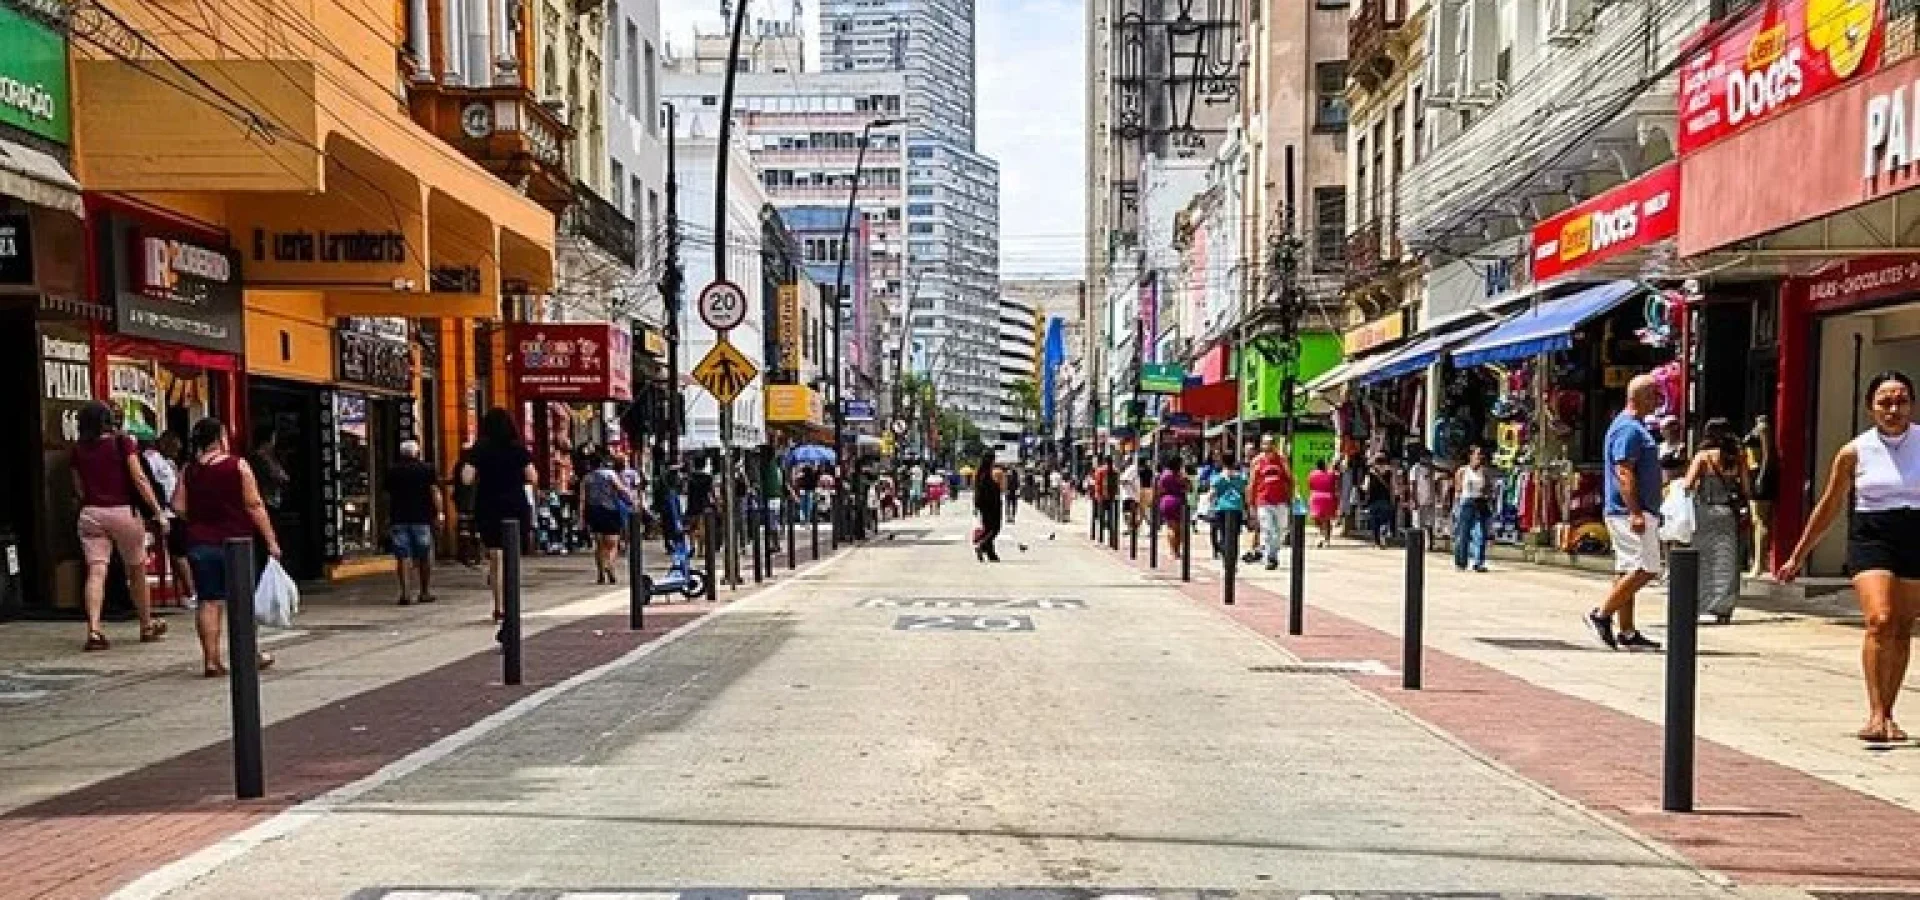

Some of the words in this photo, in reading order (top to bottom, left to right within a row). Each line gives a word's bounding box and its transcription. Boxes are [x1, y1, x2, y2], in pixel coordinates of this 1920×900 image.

[709, 292, 736, 311] 20
[44, 360, 91, 401] PIAZZA
[908, 616, 1021, 629] 20
